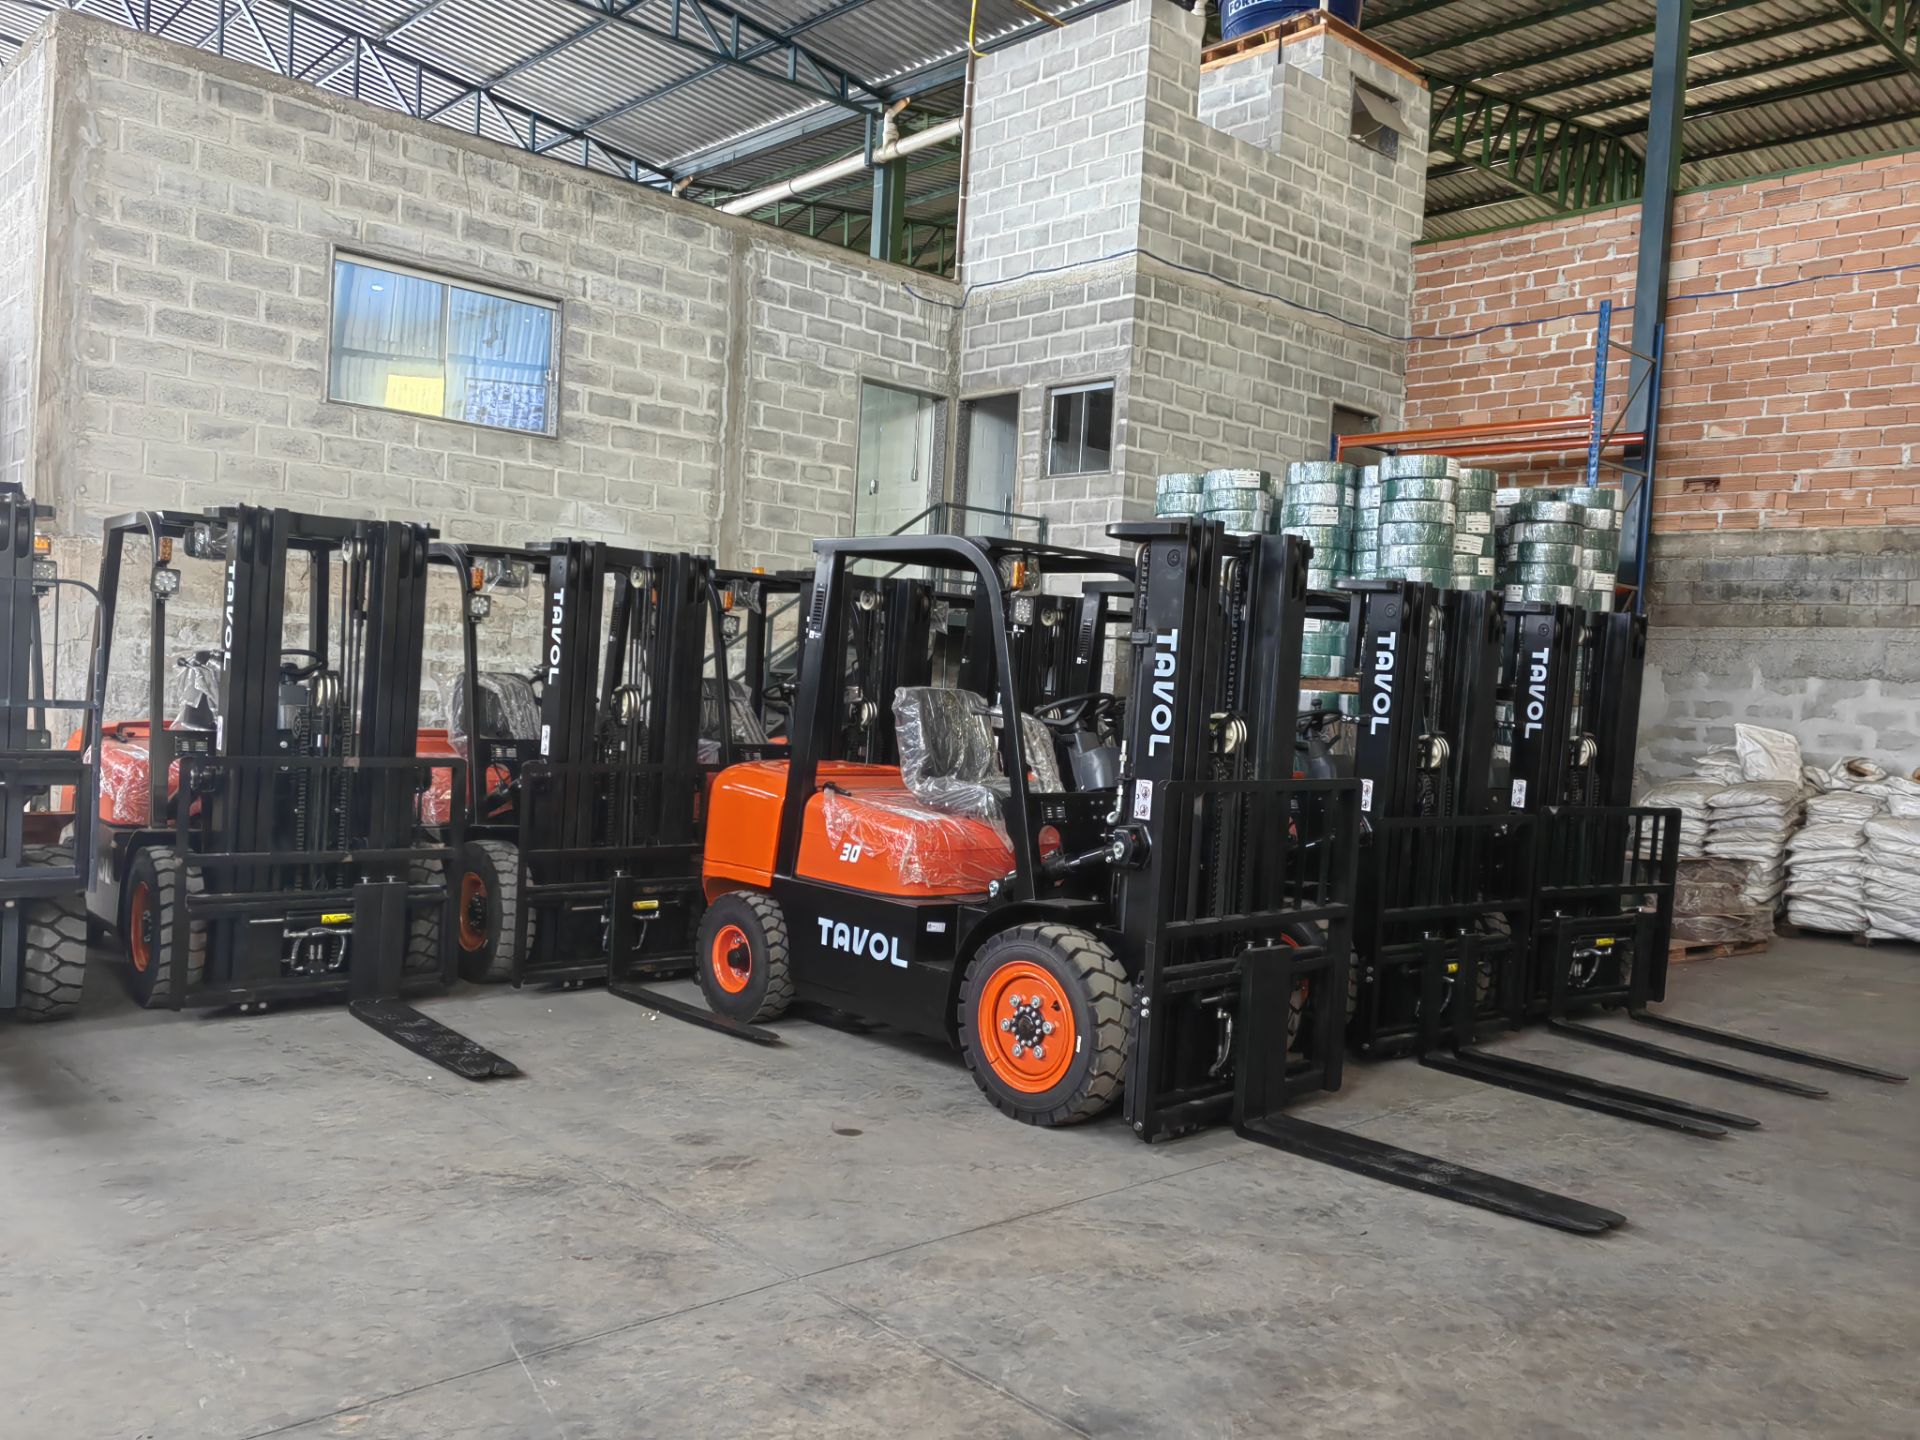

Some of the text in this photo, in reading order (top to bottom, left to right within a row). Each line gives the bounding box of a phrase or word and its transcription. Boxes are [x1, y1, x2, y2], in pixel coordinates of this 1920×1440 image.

[223, 560, 236, 671] TAVOL
[548, 588, 564, 685] TAVOL
[1148, 628, 1178, 757] TAVOL
[1370, 631, 1396, 735] TAVOL
[1524, 648, 1549, 739] TAVOL
[839, 843, 861, 863] 30
[818, 916, 908, 969] TAVOL
